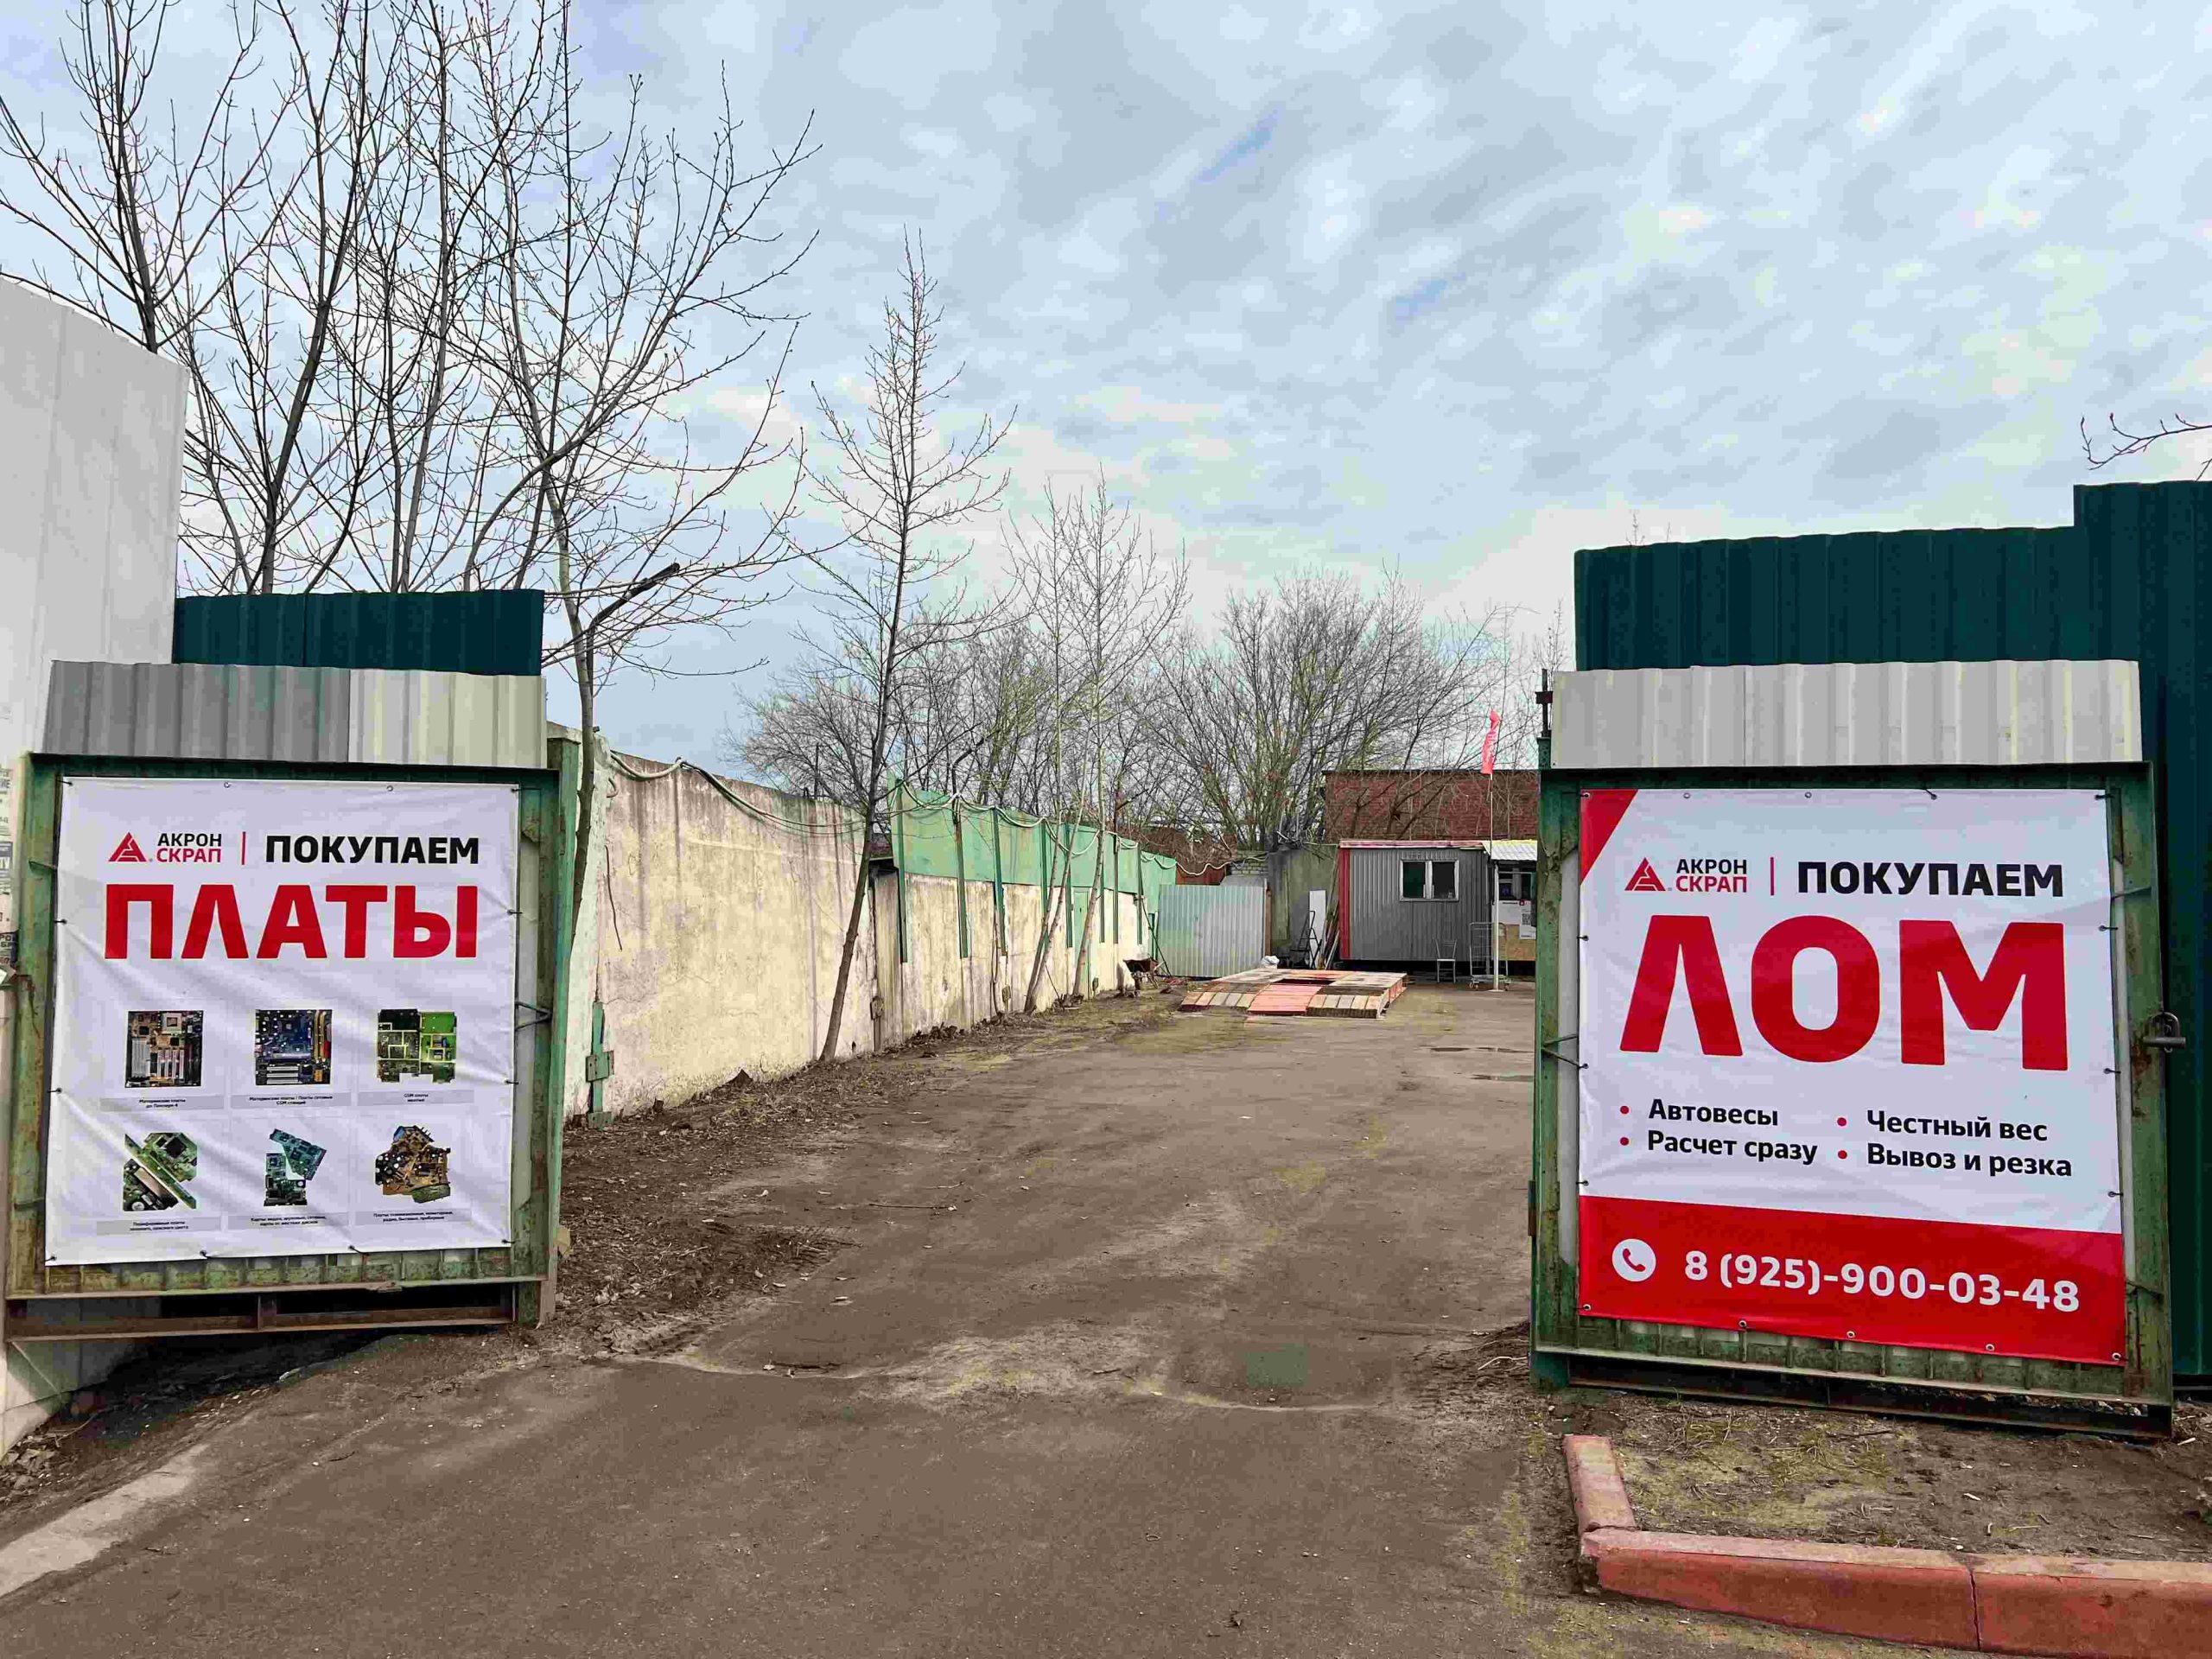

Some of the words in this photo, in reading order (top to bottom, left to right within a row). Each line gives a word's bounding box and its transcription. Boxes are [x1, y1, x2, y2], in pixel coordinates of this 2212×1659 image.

[156, 848, 222, 863] СКРАП
[157, 833, 222, 847] АКРОН
[265, 835, 479, 865] ПОКУПАЕМ
[1675, 858, 1747, 875] АКРОН
[1798, 861, 2063, 898] ПОКУПАЕМ
[1675, 875, 1747, 893] СКРАП
[105, 883, 479, 960] ПЛАТЫ
[1619, 914, 2069, 1071] ЛОМ
[1648, 1098, 1779, 1127] Автовесы
[1866, 1109, 1992, 1140] Честный
[1999, 1122, 2049, 1142] вес
[1647, 1129, 1738, 1157] Расчет
[1744, 1140, 1818, 1166] сразу
[1866, 1142, 1957, 1170] Вывоз
[1963, 1153, 1982, 1172] и
[1989, 1154, 2073, 1178] резка
[1684, 1250, 1709, 1281] 8
[1719, 1252, 2080, 1313] (925)-900-03-48
